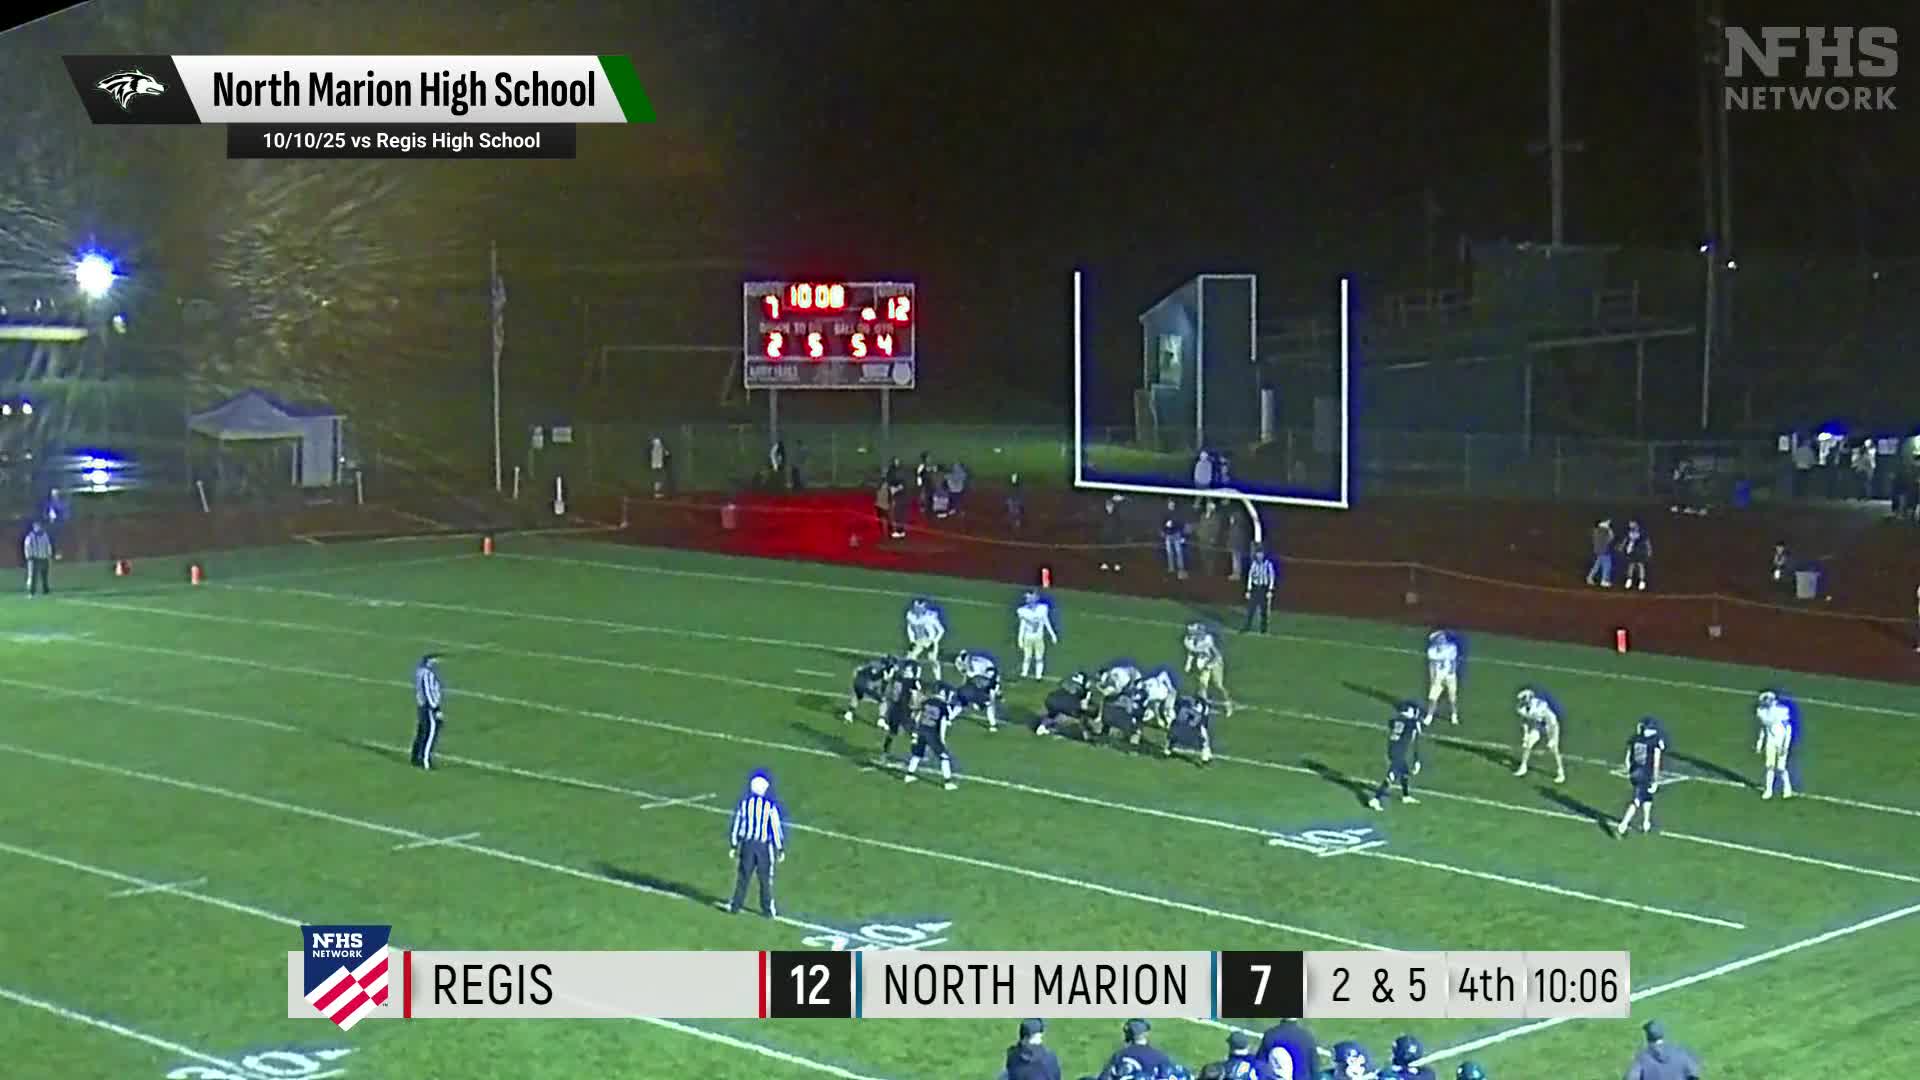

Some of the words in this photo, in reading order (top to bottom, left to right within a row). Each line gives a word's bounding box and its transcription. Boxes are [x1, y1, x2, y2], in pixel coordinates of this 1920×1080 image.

[887, 296, 910, 321] 12
[767, 331, 783, 358] 2
[807, 332, 824, 358] 5
